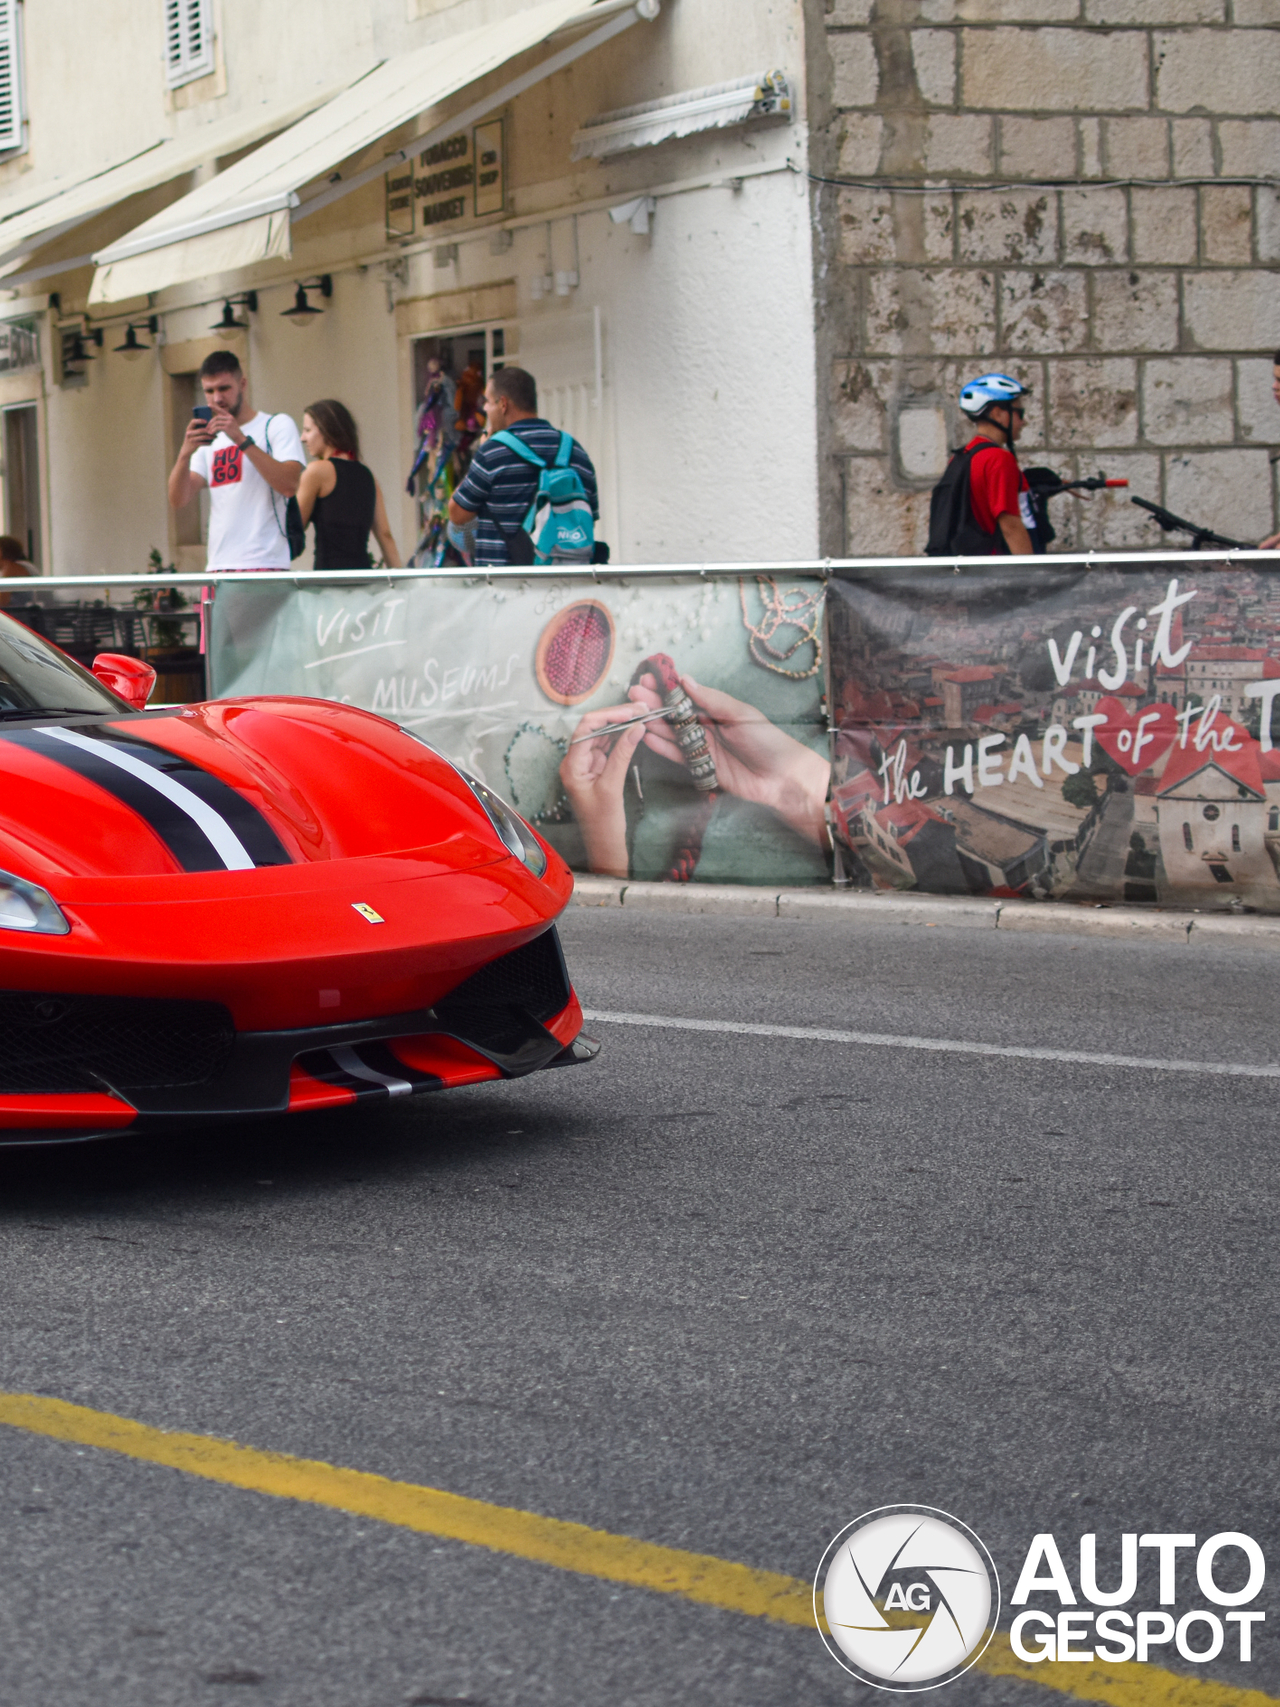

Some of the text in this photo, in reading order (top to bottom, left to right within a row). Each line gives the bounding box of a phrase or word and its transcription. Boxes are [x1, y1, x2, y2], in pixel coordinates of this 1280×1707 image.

[371, 654, 519, 715] MUSEUMS
[878, 739, 928, 805] the
[943, 714, 1108, 795] HEART
[1175, 695, 1243, 752] the
